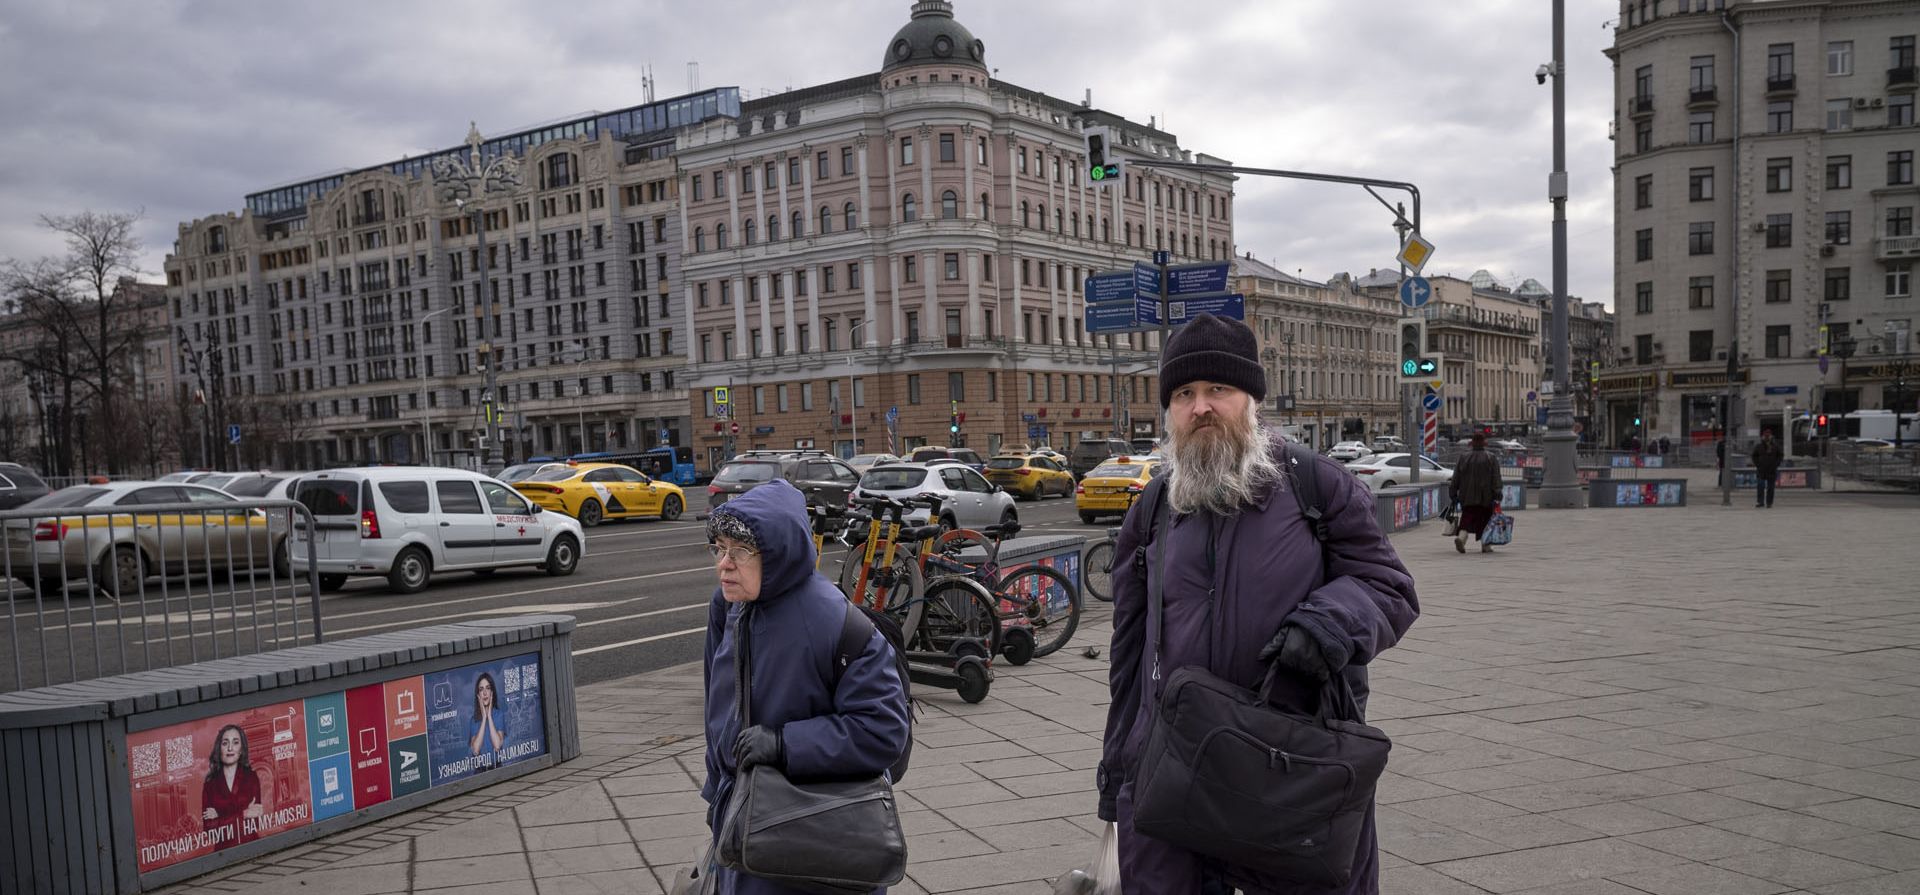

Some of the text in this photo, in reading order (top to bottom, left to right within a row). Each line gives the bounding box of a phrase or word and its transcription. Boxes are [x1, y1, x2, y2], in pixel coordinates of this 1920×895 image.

[438, 739, 539, 779] УЗНАВАЙ ГОРОД НА UM.MOS.RU
[141, 803, 308, 865] ПОЛУЧАЙ УСЛУГИ НА MY.MOS.RU
